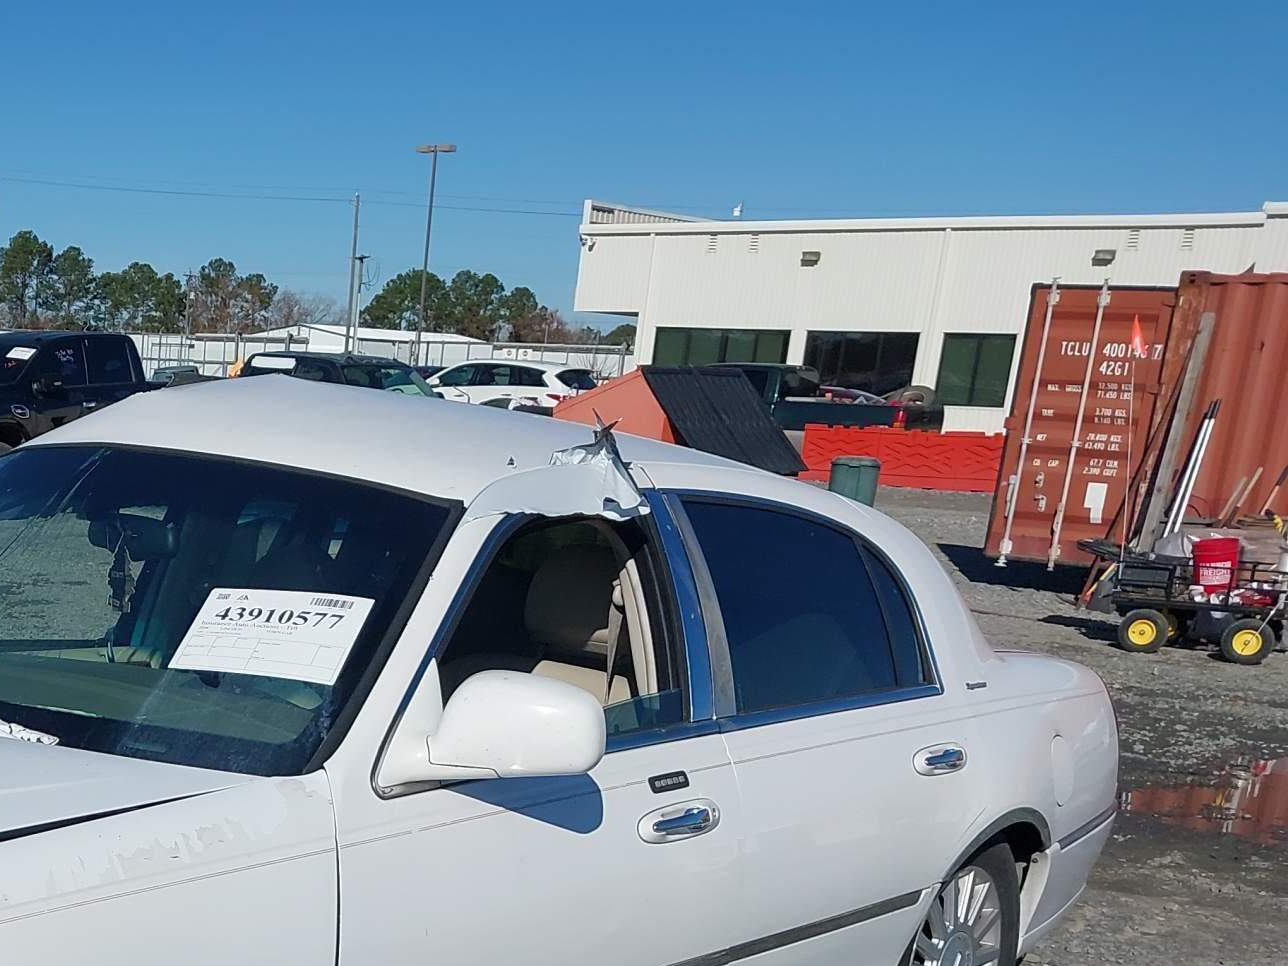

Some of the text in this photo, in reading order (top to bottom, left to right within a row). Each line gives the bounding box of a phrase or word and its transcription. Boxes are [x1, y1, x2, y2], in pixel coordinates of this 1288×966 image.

[1060, 341, 1091, 357] TCLU
[1099, 361, 1129, 376] 42G1
[215, 605, 345, 630] 43910577
